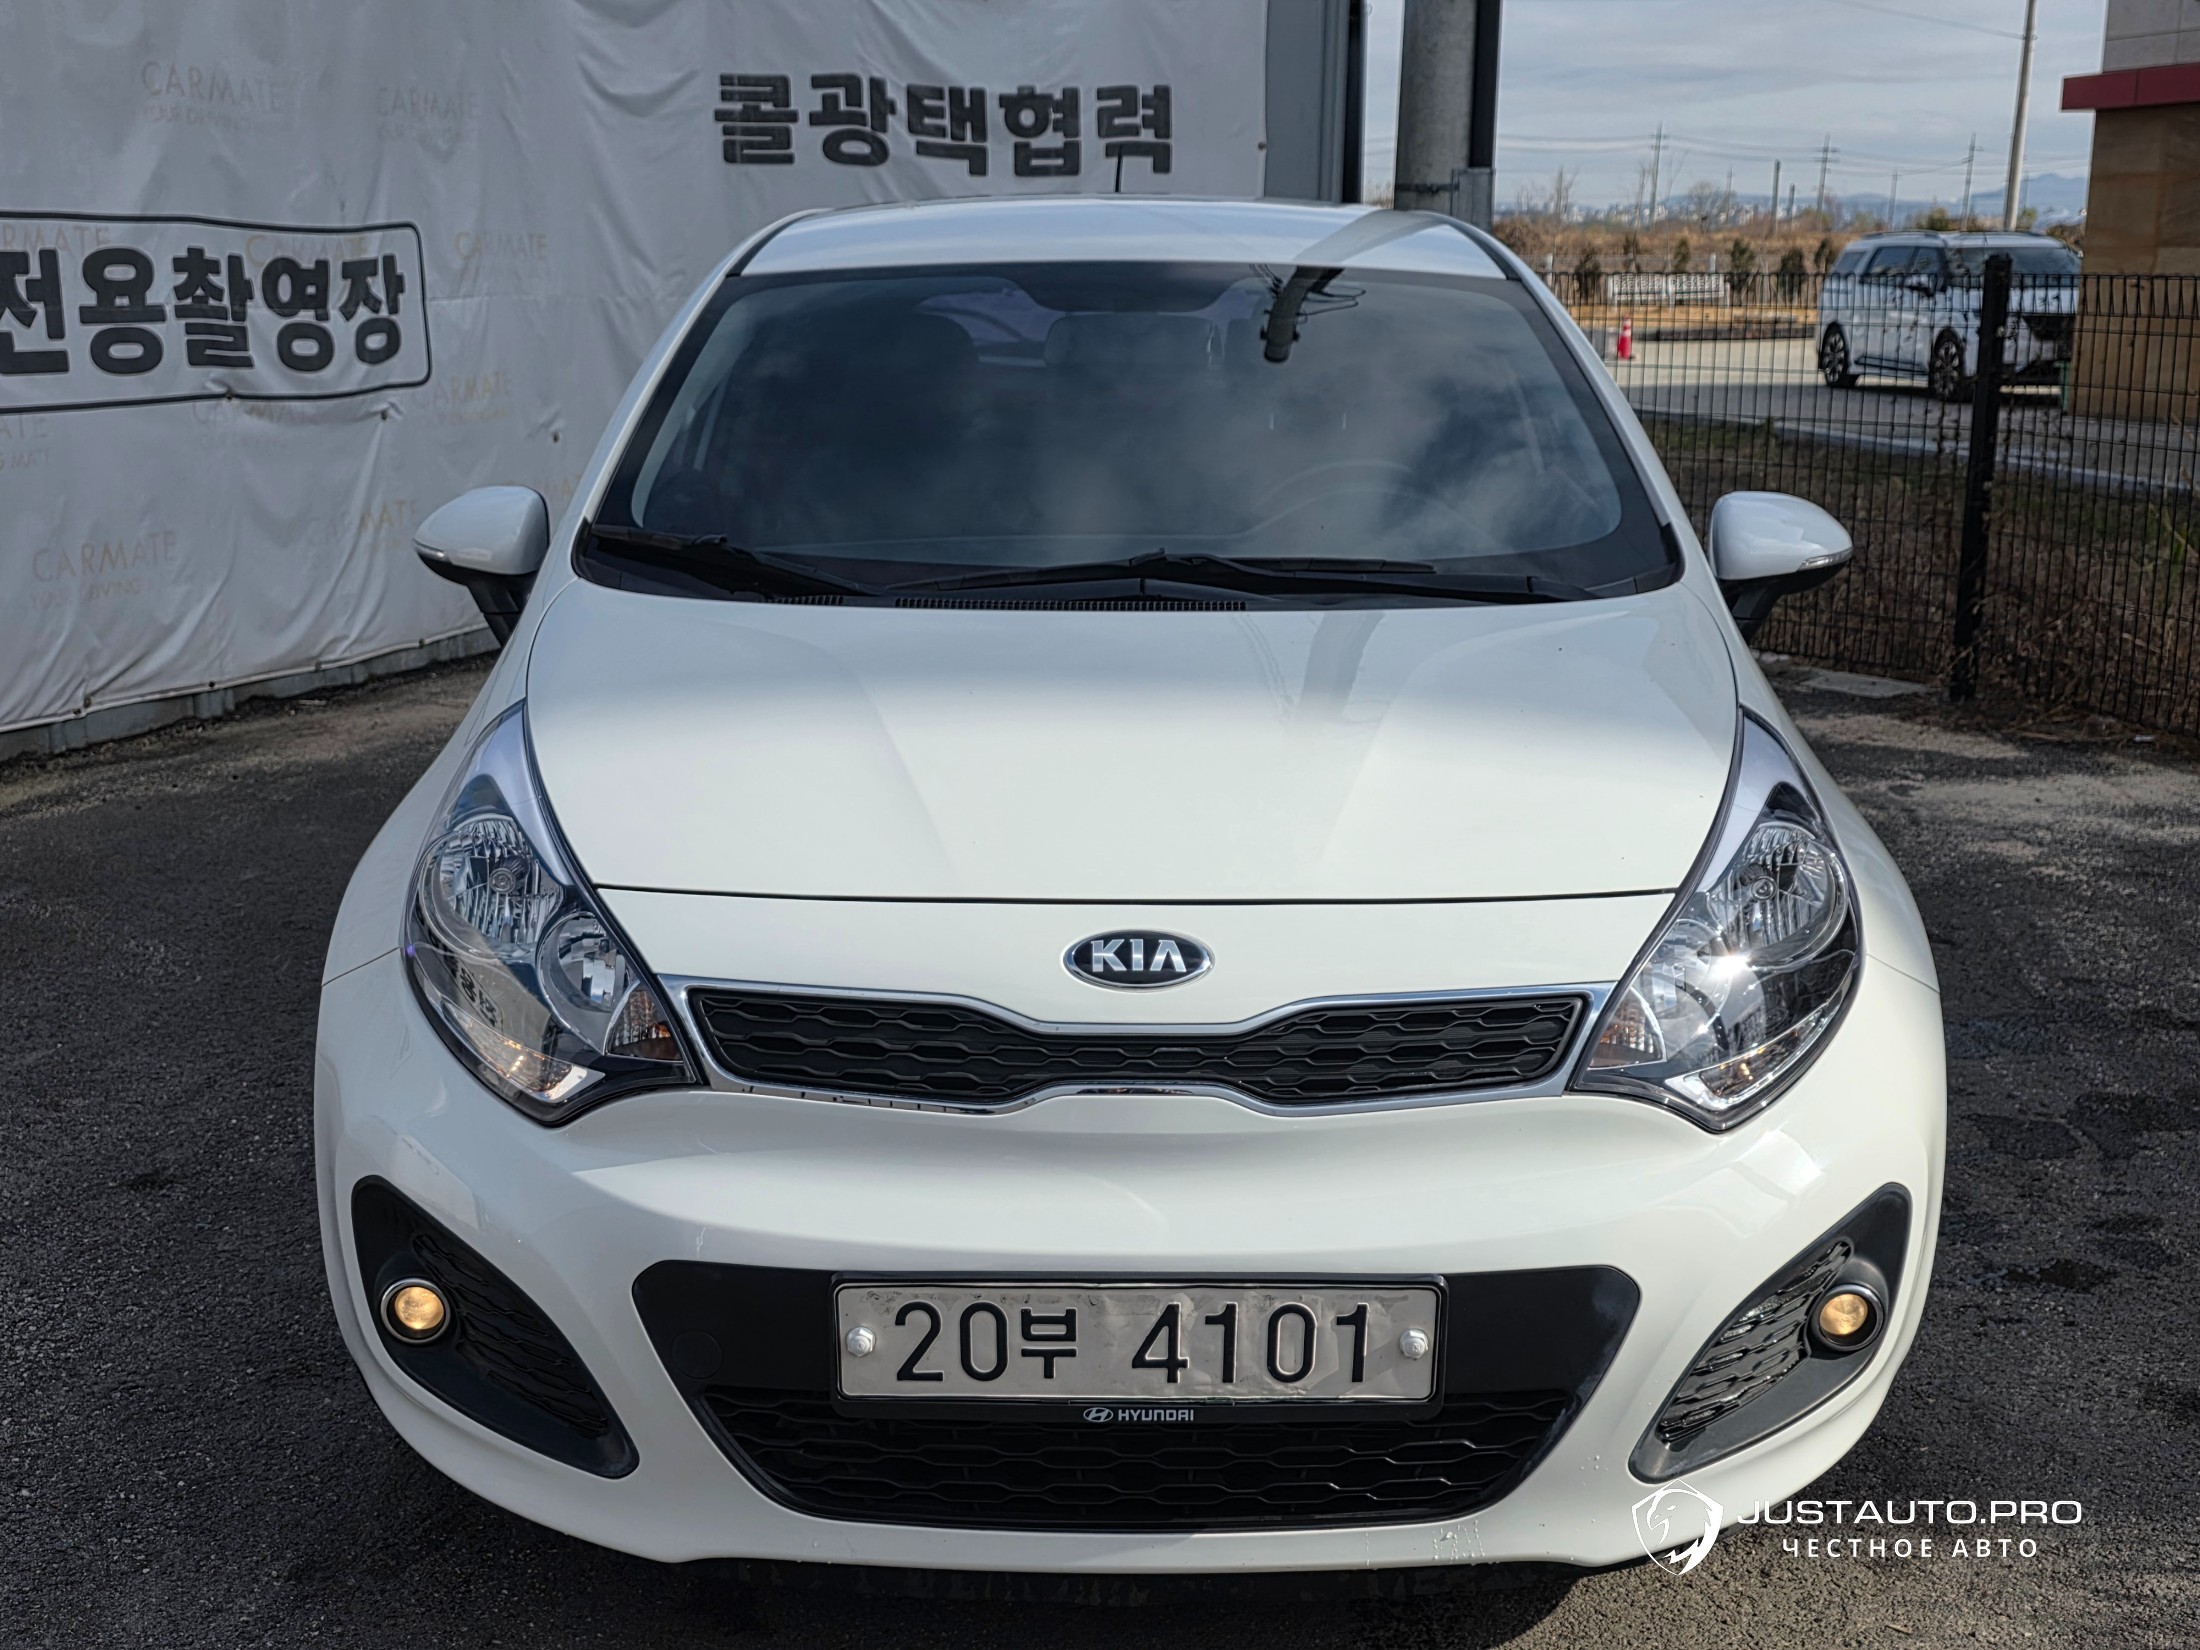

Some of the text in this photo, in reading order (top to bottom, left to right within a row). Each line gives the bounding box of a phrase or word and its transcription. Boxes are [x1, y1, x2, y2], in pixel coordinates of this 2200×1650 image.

[714, 73, 1172, 177] 콜광택협력
[31, 530, 177, 582] CARMATE
[1090, 938, 1187, 973] KIA
[894, 1301, 1371, 1384] 20부 4101
[1117, 1408, 1195, 1422] HYUNDAI
